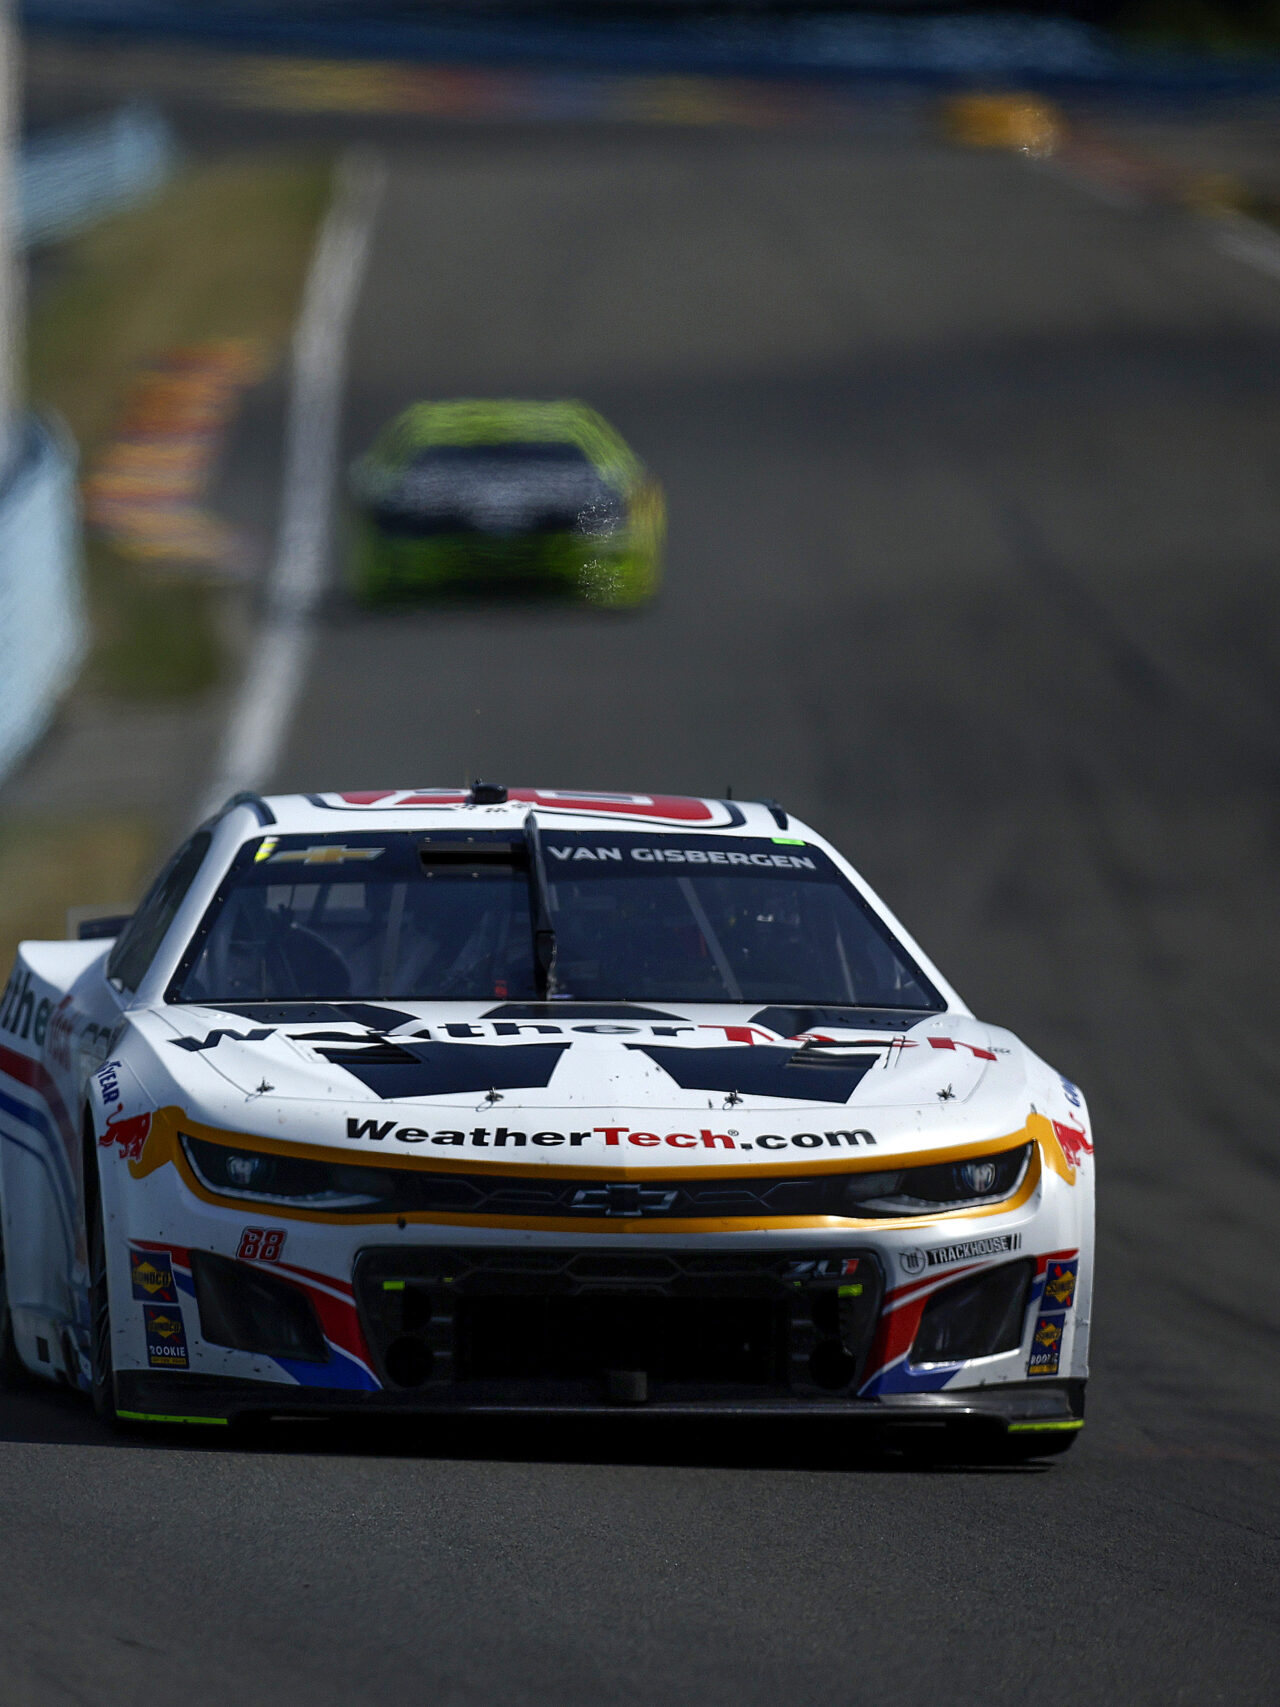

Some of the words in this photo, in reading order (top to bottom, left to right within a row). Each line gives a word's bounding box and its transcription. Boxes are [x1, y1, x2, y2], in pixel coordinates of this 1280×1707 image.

[547, 846, 621, 861] VAN
[631, 848, 816, 869] GISBERGEN
[237, 1226, 288, 1262] 88
[931, 1236, 1009, 1264] TRACKHOUSE
[784, 1259, 860, 1276] ZL1
[150, 1345, 186, 1357] ROOKIE
